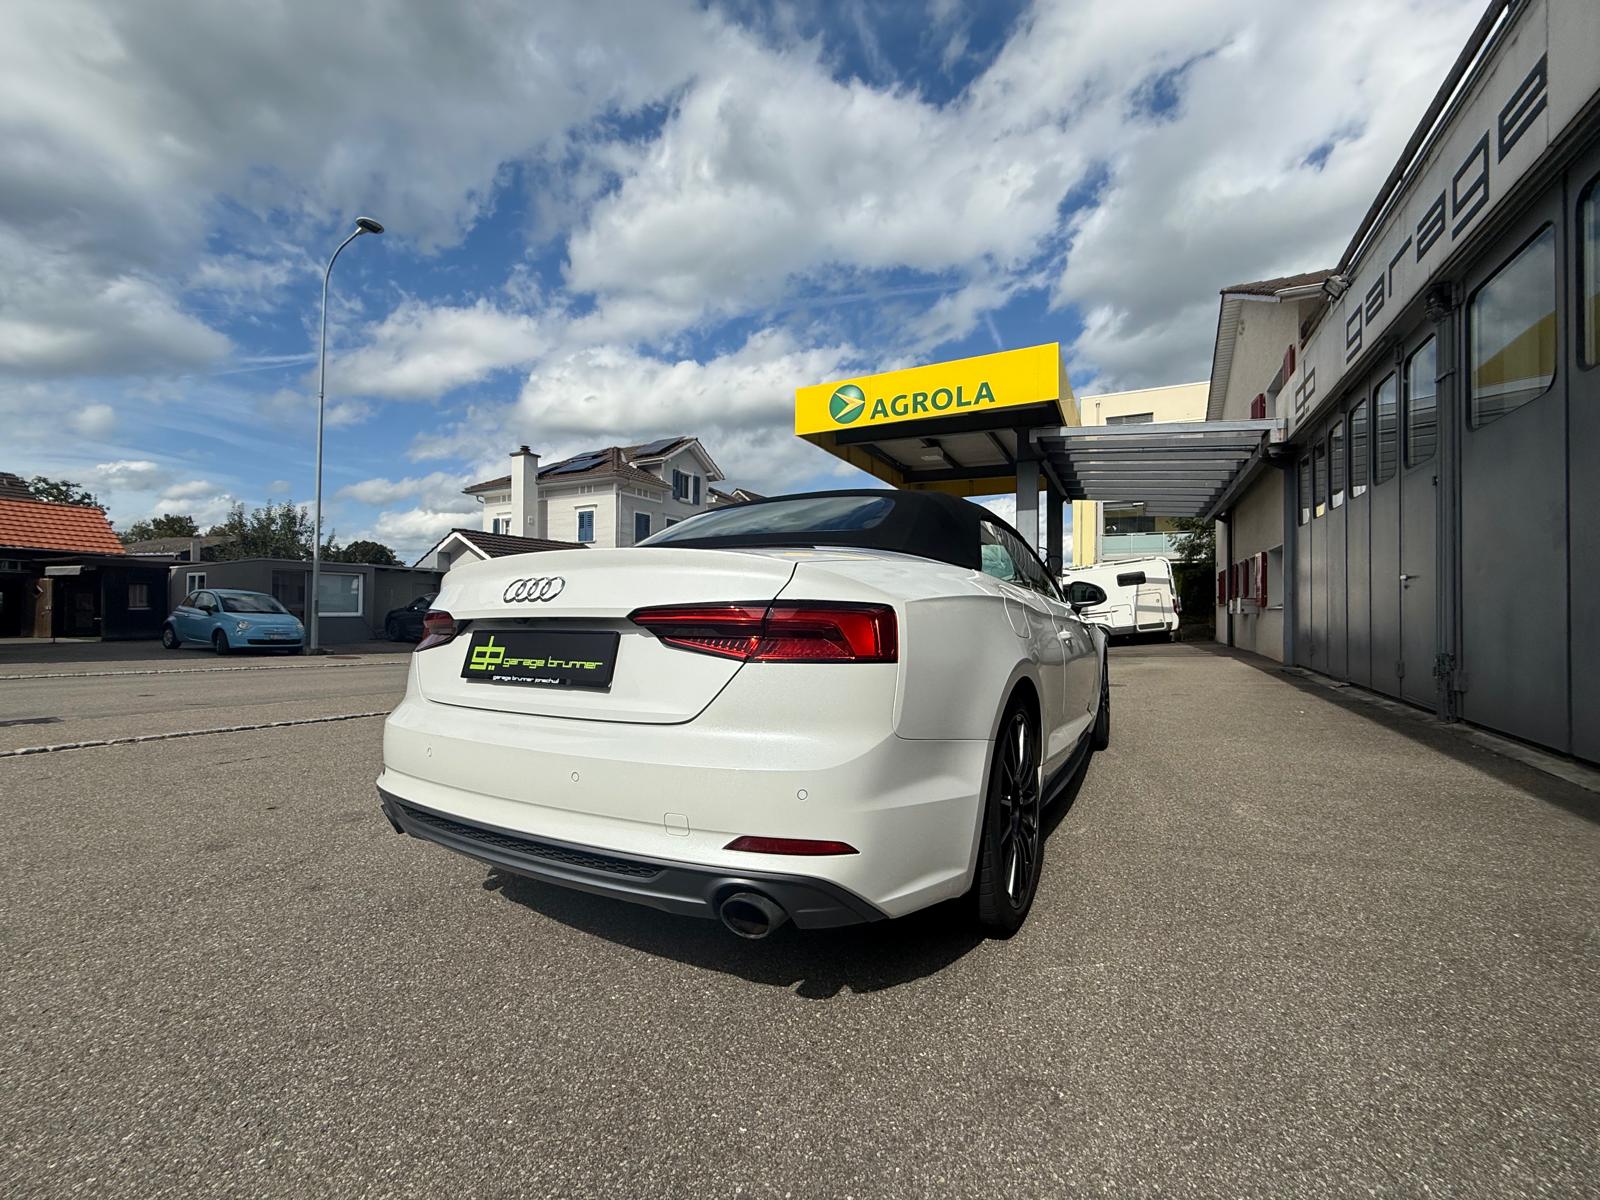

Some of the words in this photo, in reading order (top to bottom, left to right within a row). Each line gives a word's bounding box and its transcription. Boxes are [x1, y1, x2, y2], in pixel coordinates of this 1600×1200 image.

[1346, 50, 1548, 365] garage
[869, 381, 996, 420] AGROLA
[502, 657, 545, 669] garage
[547, 656, 604, 670] brunner
